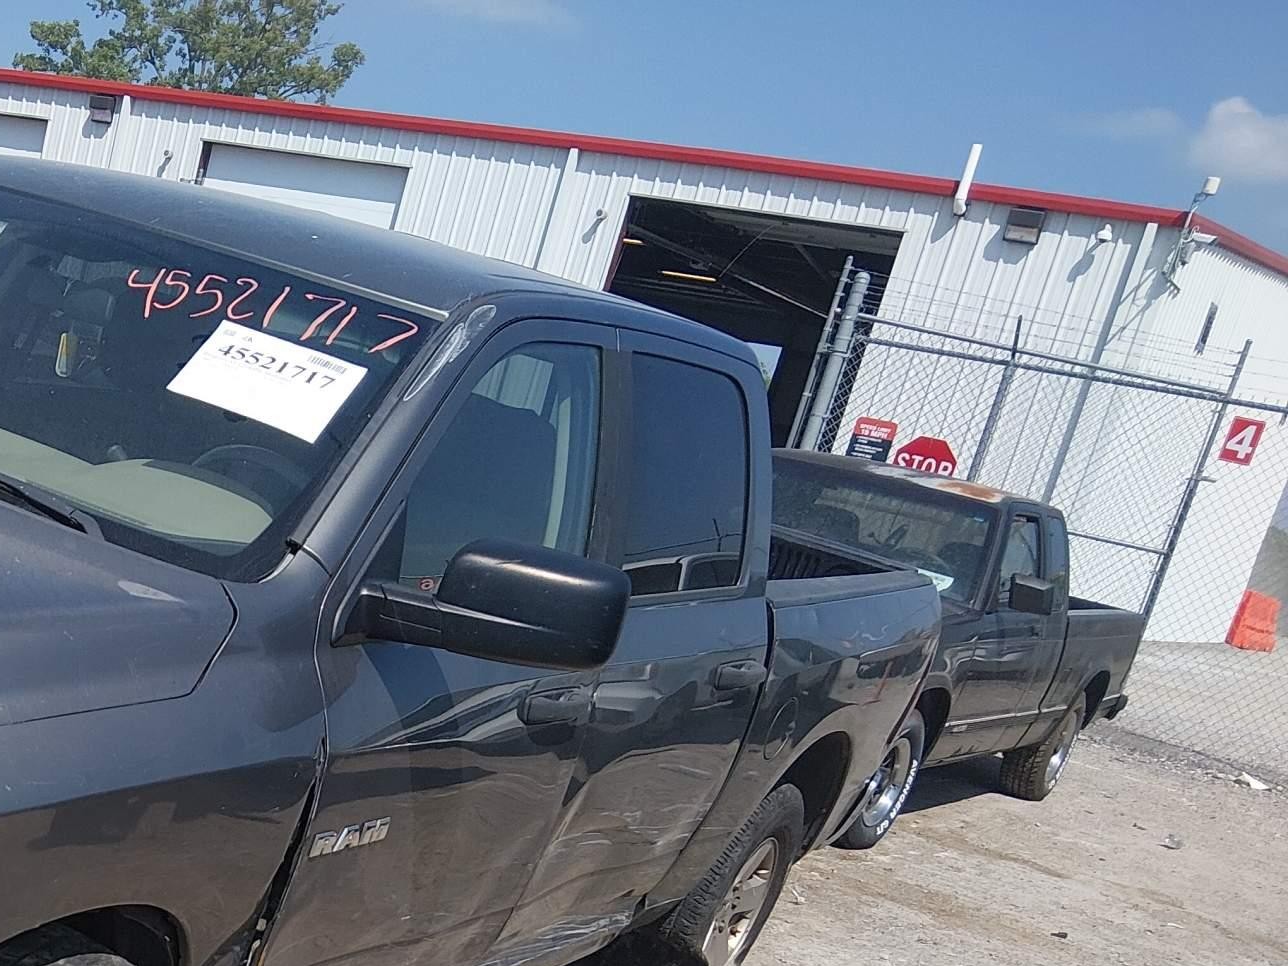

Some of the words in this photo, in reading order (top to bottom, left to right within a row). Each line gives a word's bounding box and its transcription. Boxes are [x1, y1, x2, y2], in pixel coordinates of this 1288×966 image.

[127, 268, 419, 354] 45521717
[218, 344, 337, 389] 45521717
[1225, 425, 1258, 460] 4
[896, 452, 953, 477] STOP
[890, 759, 919, 820] AVENGER
[308, 816, 392, 858] RAM
